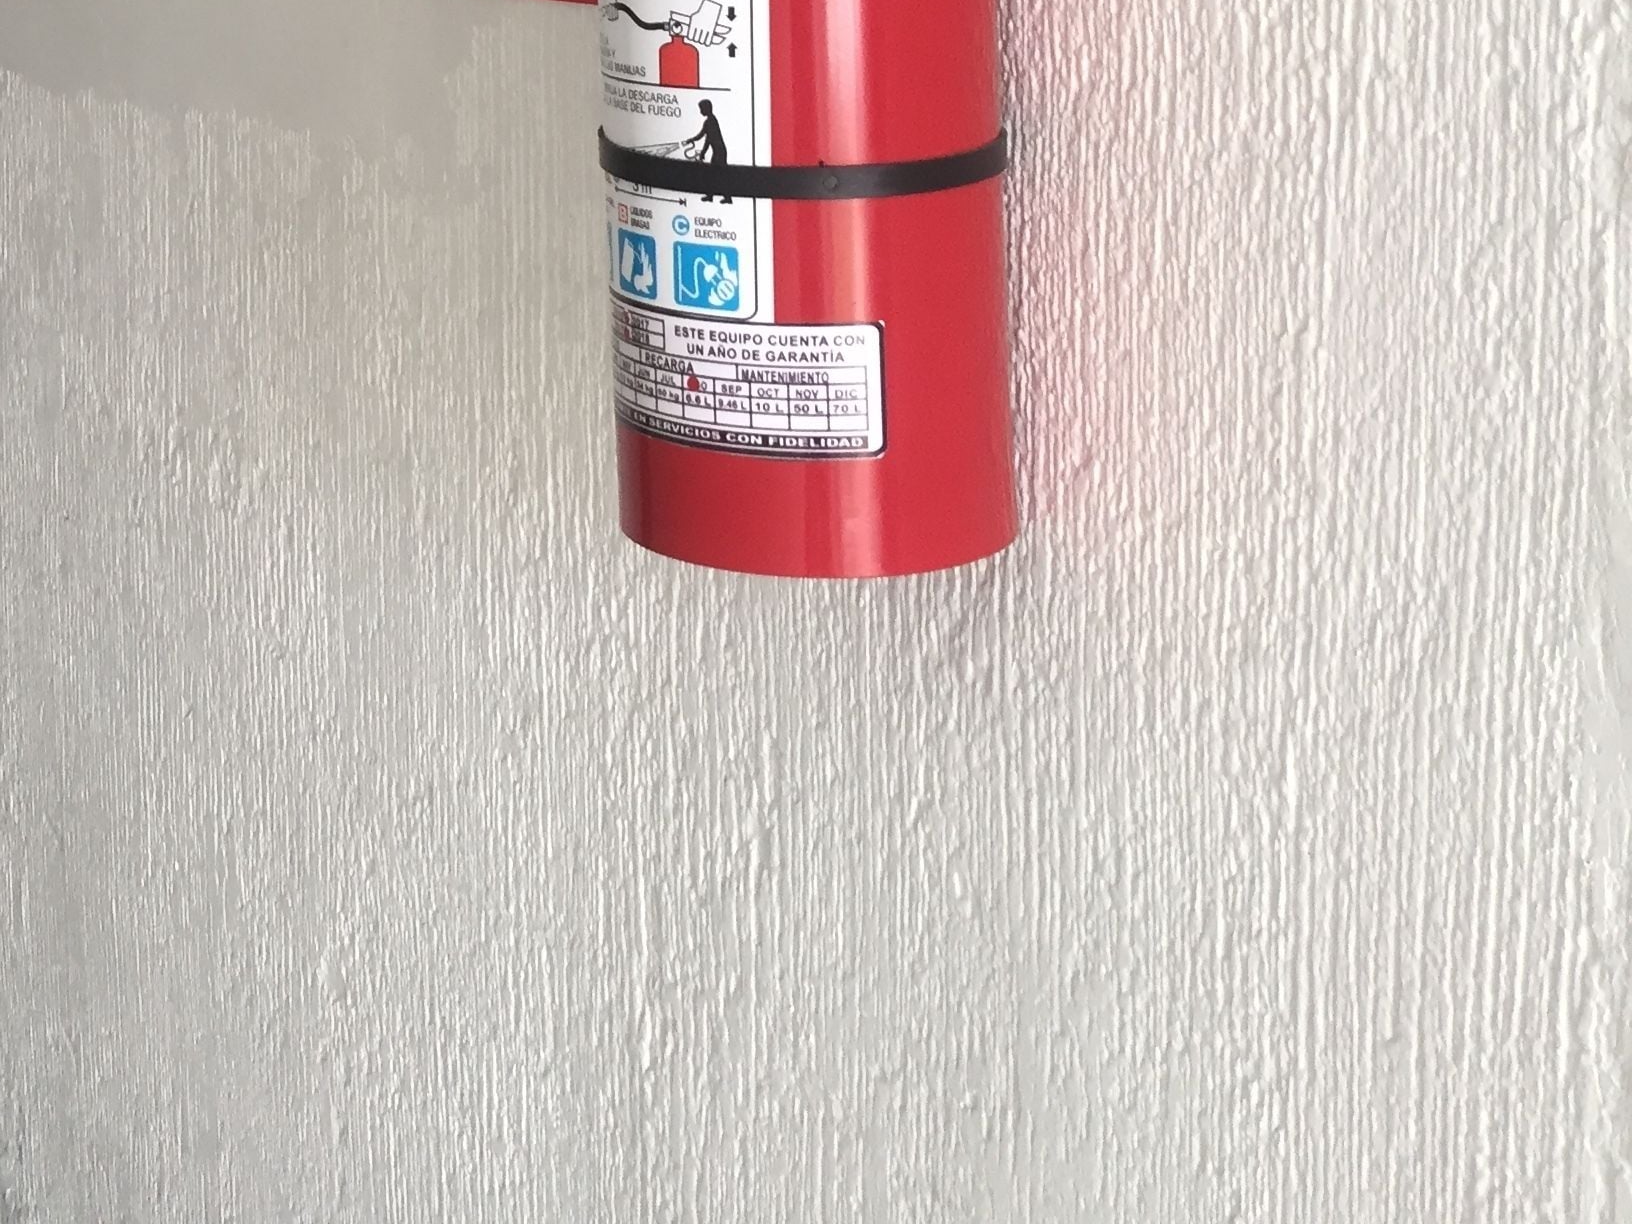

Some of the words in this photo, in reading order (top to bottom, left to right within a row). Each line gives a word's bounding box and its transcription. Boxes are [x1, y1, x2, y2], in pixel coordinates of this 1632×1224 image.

[628, 89, 679, 105] DESCARGA
[630, 102, 646, 114] DEL
[648, 104, 682, 118] FUEGO
[618, 204, 628, 223] B
[675, 217, 688, 233] C
[694, 217, 722, 228] EQUIPO
[694, 229, 737, 241] ELECTRICO
[674, 325, 705, 341] ESTE
[709, 330, 763, 346] EQUIPO
[768, 334, 829, 347] CUENTA
[833, 335, 865, 347] CON
[686, 343, 704, 356] UN
[707, 344, 737, 360] AÑO
[741, 349, 761, 362] DE
[644, 352, 695, 375] RECARGA
[660, 373, 676, 386] JUL
[741, 369, 829, 384] MANTENIMIENTO
[721, 383, 742, 394] SEP
[757, 387, 780, 398] OCT
[795, 388, 819, 399] NOV
[835, 389, 858, 399] DIC
[704, 396, 711, 408] L
[741, 400, 747, 410] L
[755, 402, 770, 412] 10
[794, 404, 809, 414] 50
[649, 417, 721, 441] SERVICIOS
[726, 431, 763, 445] CON
[768, 436, 864, 448] FIDELIDAD
